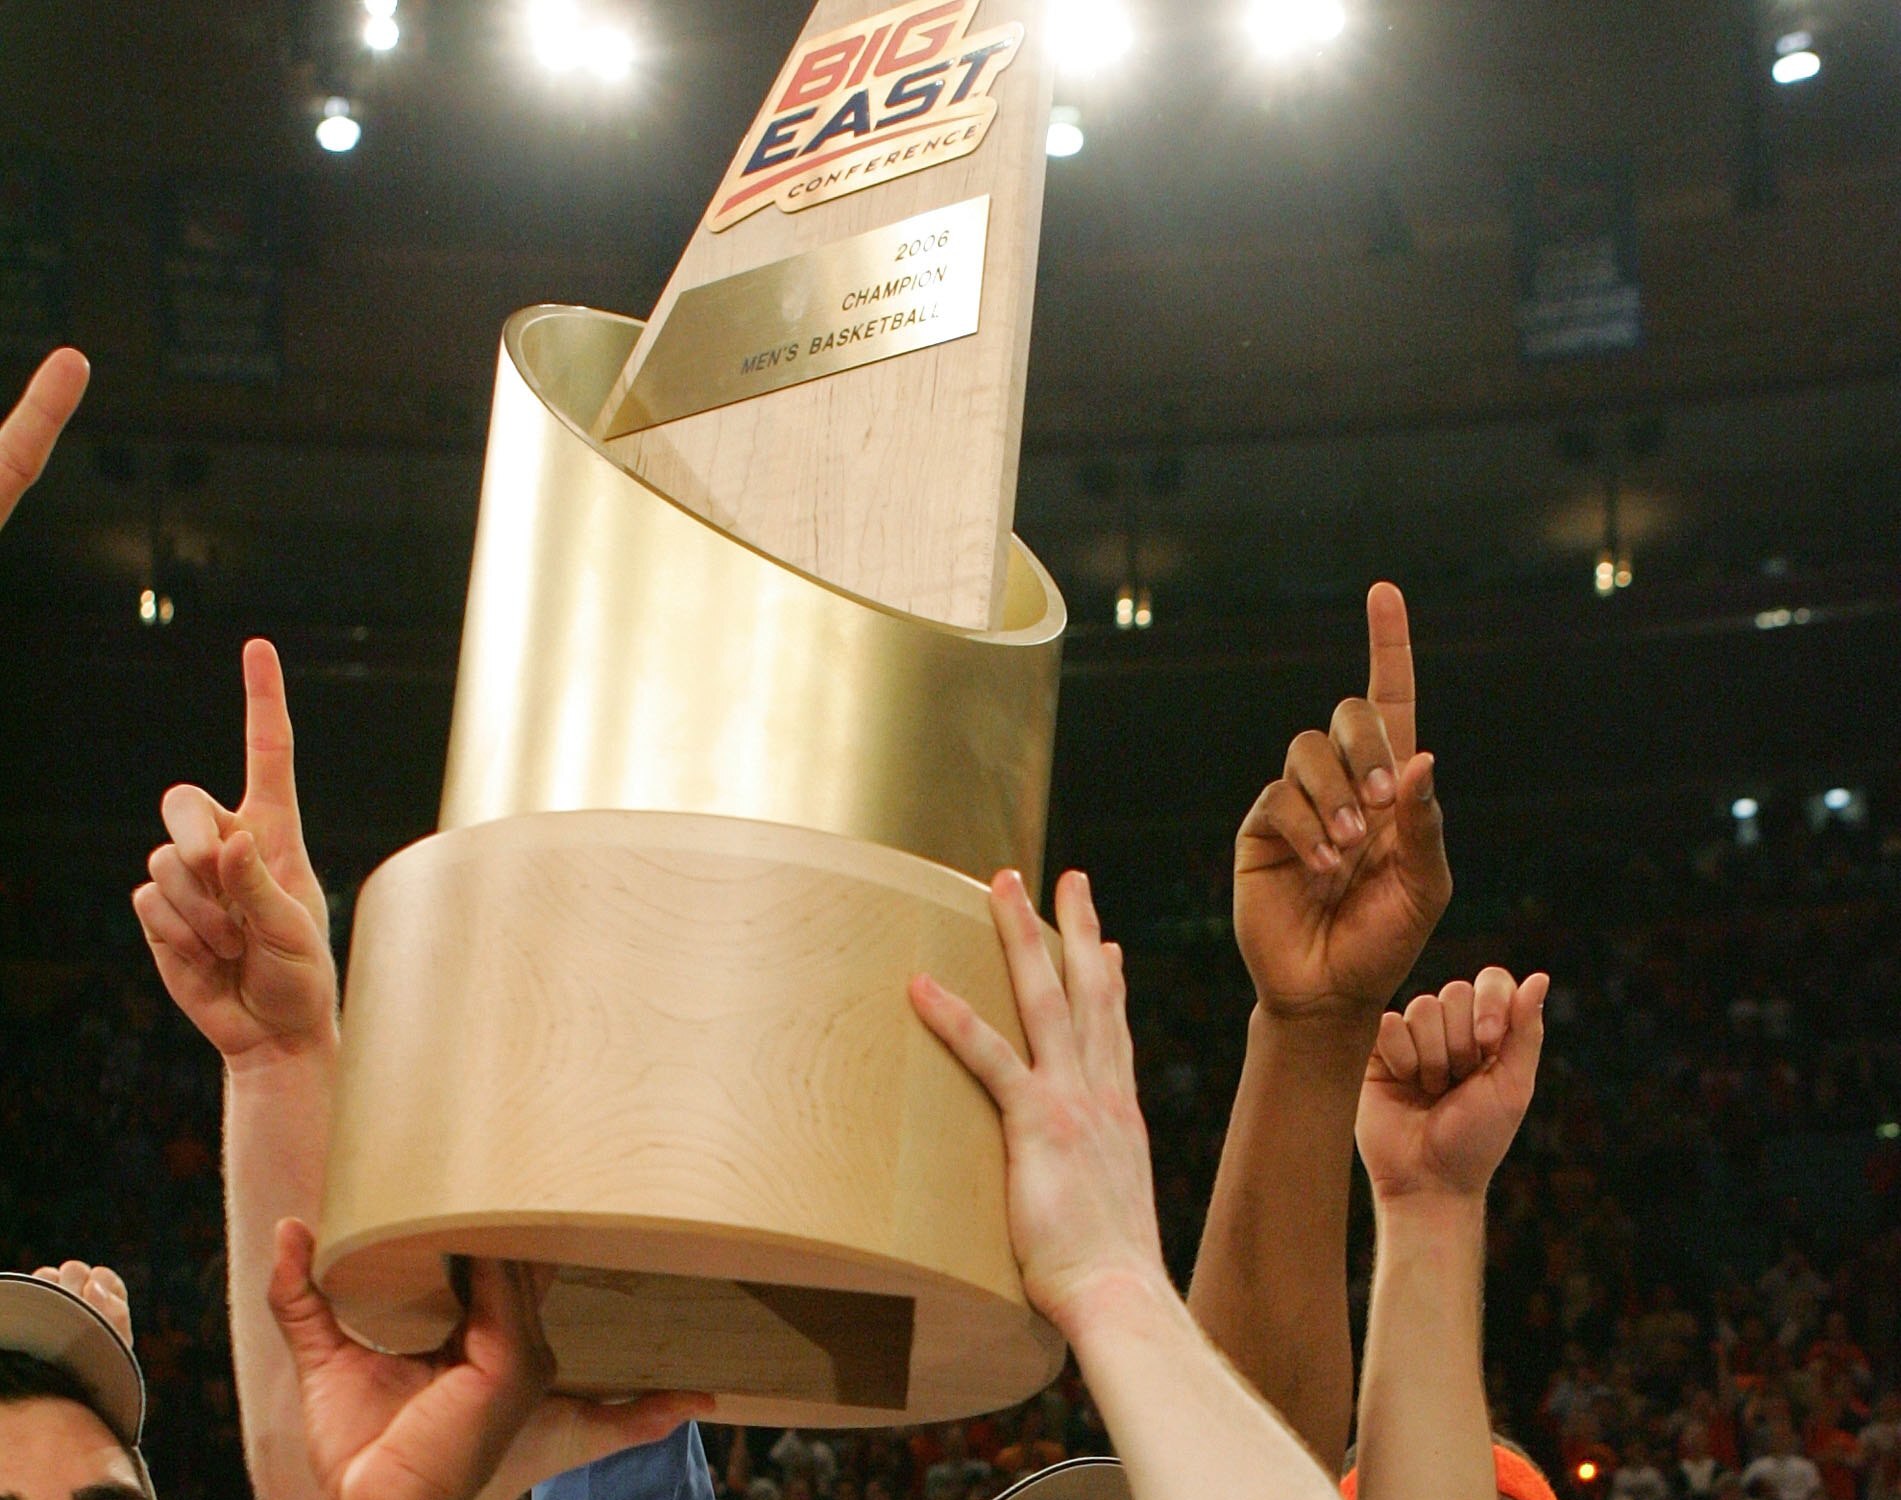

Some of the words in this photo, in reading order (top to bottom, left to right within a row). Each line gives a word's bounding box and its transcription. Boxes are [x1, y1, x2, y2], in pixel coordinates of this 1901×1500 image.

[774, 0, 965, 113] BIG
[741, 37, 1015, 178] EAST
[787, 124, 978, 199] CONFERENCE
[894, 229, 951, 262] 2006
[842, 265, 948, 311] CHAMPION
[740, 343, 799, 375] MEN'S
[809, 302, 940, 355] BASKETBALL
